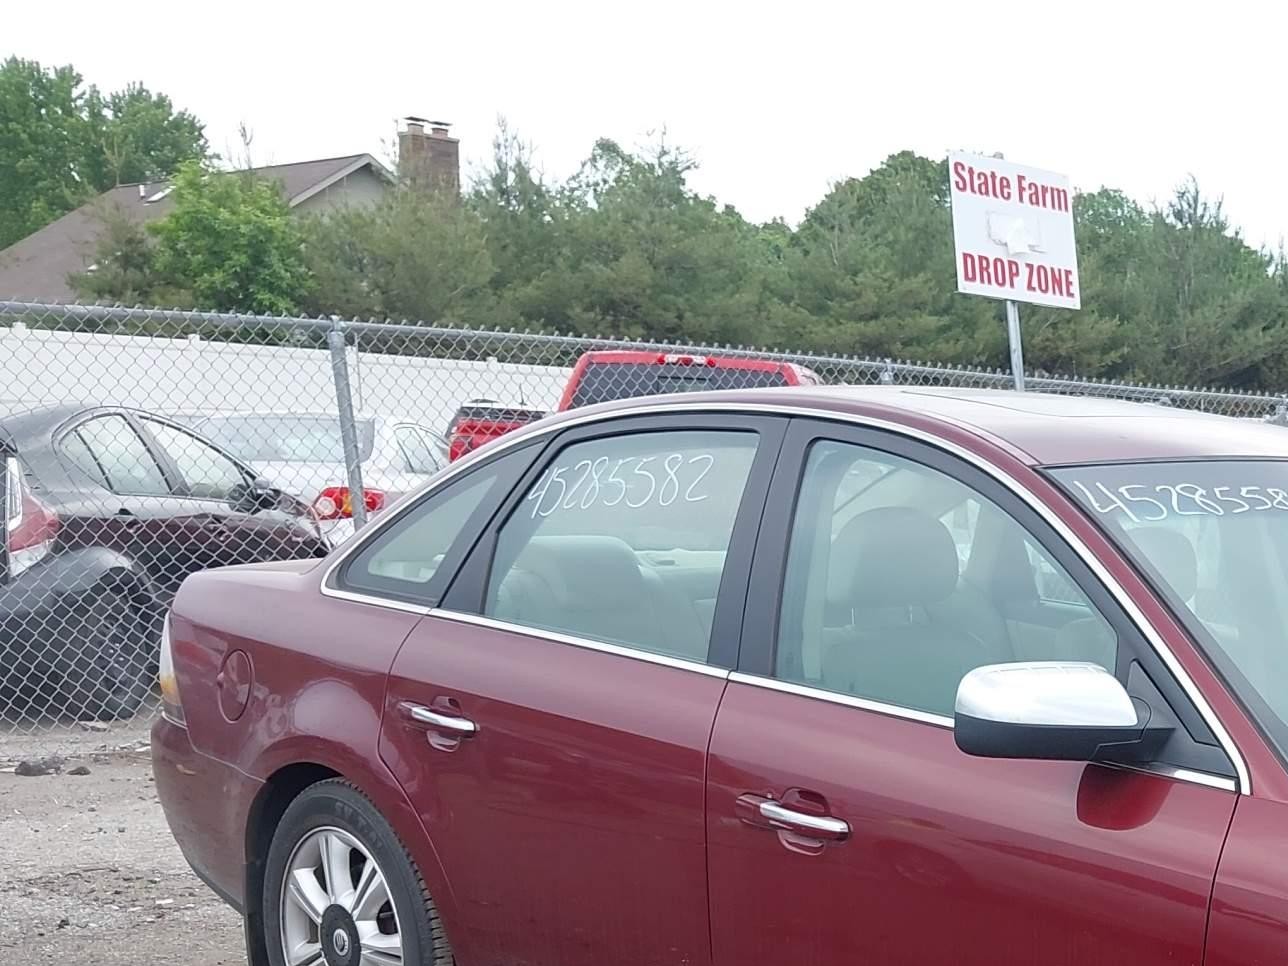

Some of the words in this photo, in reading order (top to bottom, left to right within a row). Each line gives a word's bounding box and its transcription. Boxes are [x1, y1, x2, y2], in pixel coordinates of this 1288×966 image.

[953, 161, 1012, 201] State
[1017, 174, 1069, 213] Farm
[962, 252, 1019, 289] DROP
[1025, 262, 1075, 298] ZONE
[527, 453, 714, 519] 45285582
